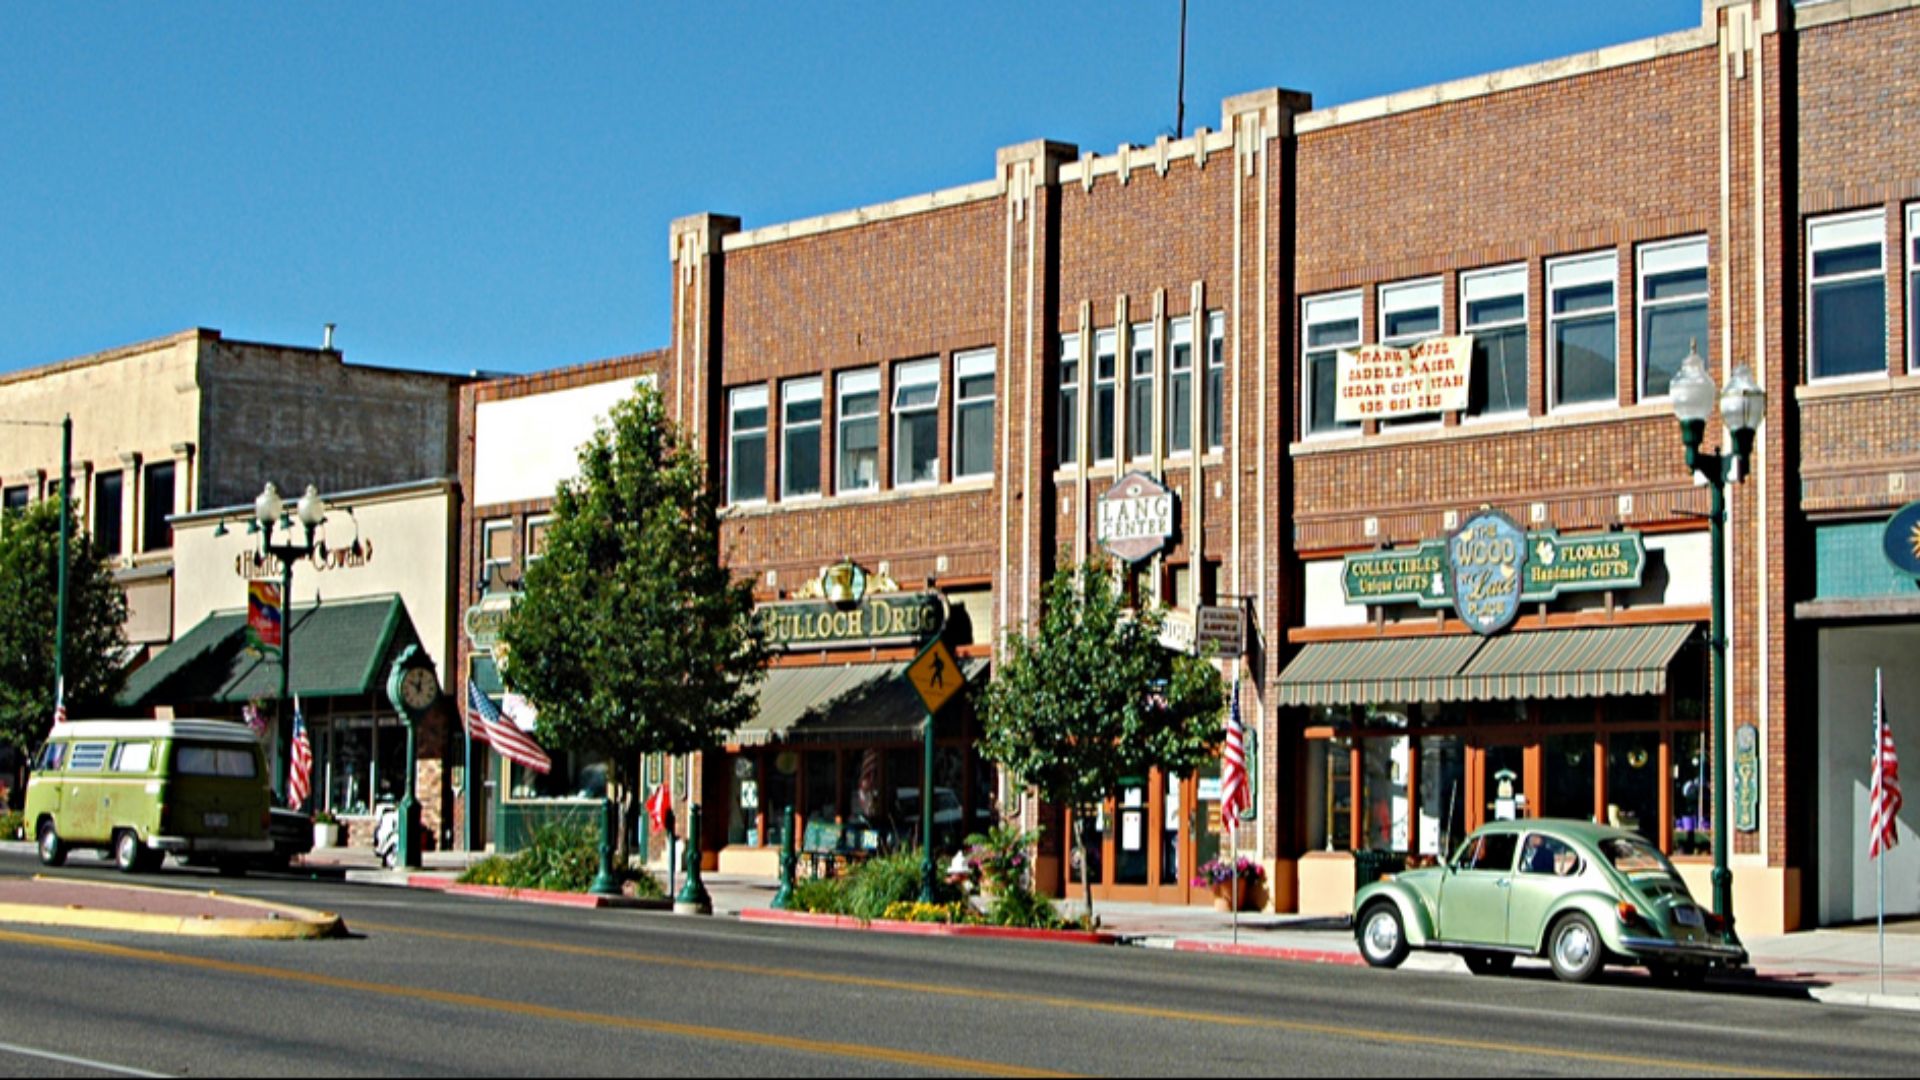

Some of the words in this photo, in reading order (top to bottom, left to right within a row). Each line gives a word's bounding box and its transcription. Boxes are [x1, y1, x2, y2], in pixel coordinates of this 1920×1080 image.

[1390, 379, 1423, 395] CITY
[1103, 497, 1168, 521] LANG
[1103, 518, 1166, 537] CENTER
[1455, 538, 1516, 567] WOOD
[1560, 542, 1620, 562] FLORALS
[1352, 556, 1441, 578] COLLECTIBLES
[1590, 560, 1629, 578] GIFTS
[1394, 574, 1429, 592] GIFTS
[1467, 602, 1506, 617] PLACE
[762, 605, 864, 643] BULLOCH
